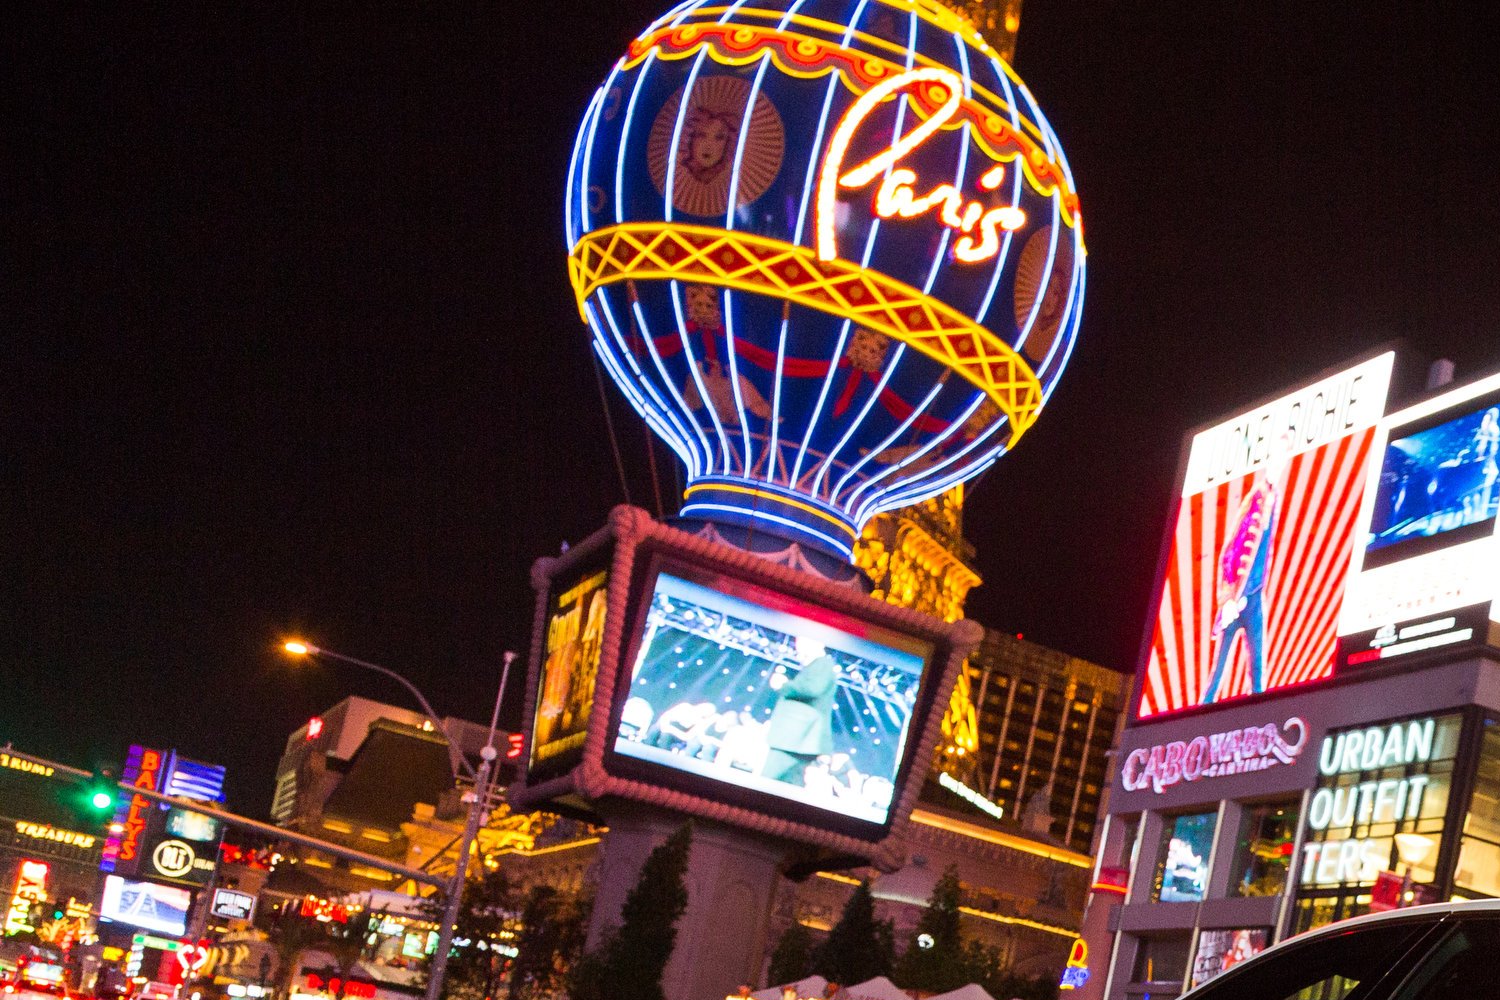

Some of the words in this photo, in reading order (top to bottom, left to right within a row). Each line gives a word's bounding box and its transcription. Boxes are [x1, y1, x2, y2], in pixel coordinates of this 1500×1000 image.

[818, 67, 1026, 263] Paris
[1121, 735, 1211, 795] CABO
[1209, 719, 1292, 764] WABO
[1319, 716, 1436, 777] URBAN
[1308, 774, 1429, 831] OUTFIT
[16, 820, 96, 849] TREASURE
[1300, 838, 1378, 886] TERS
